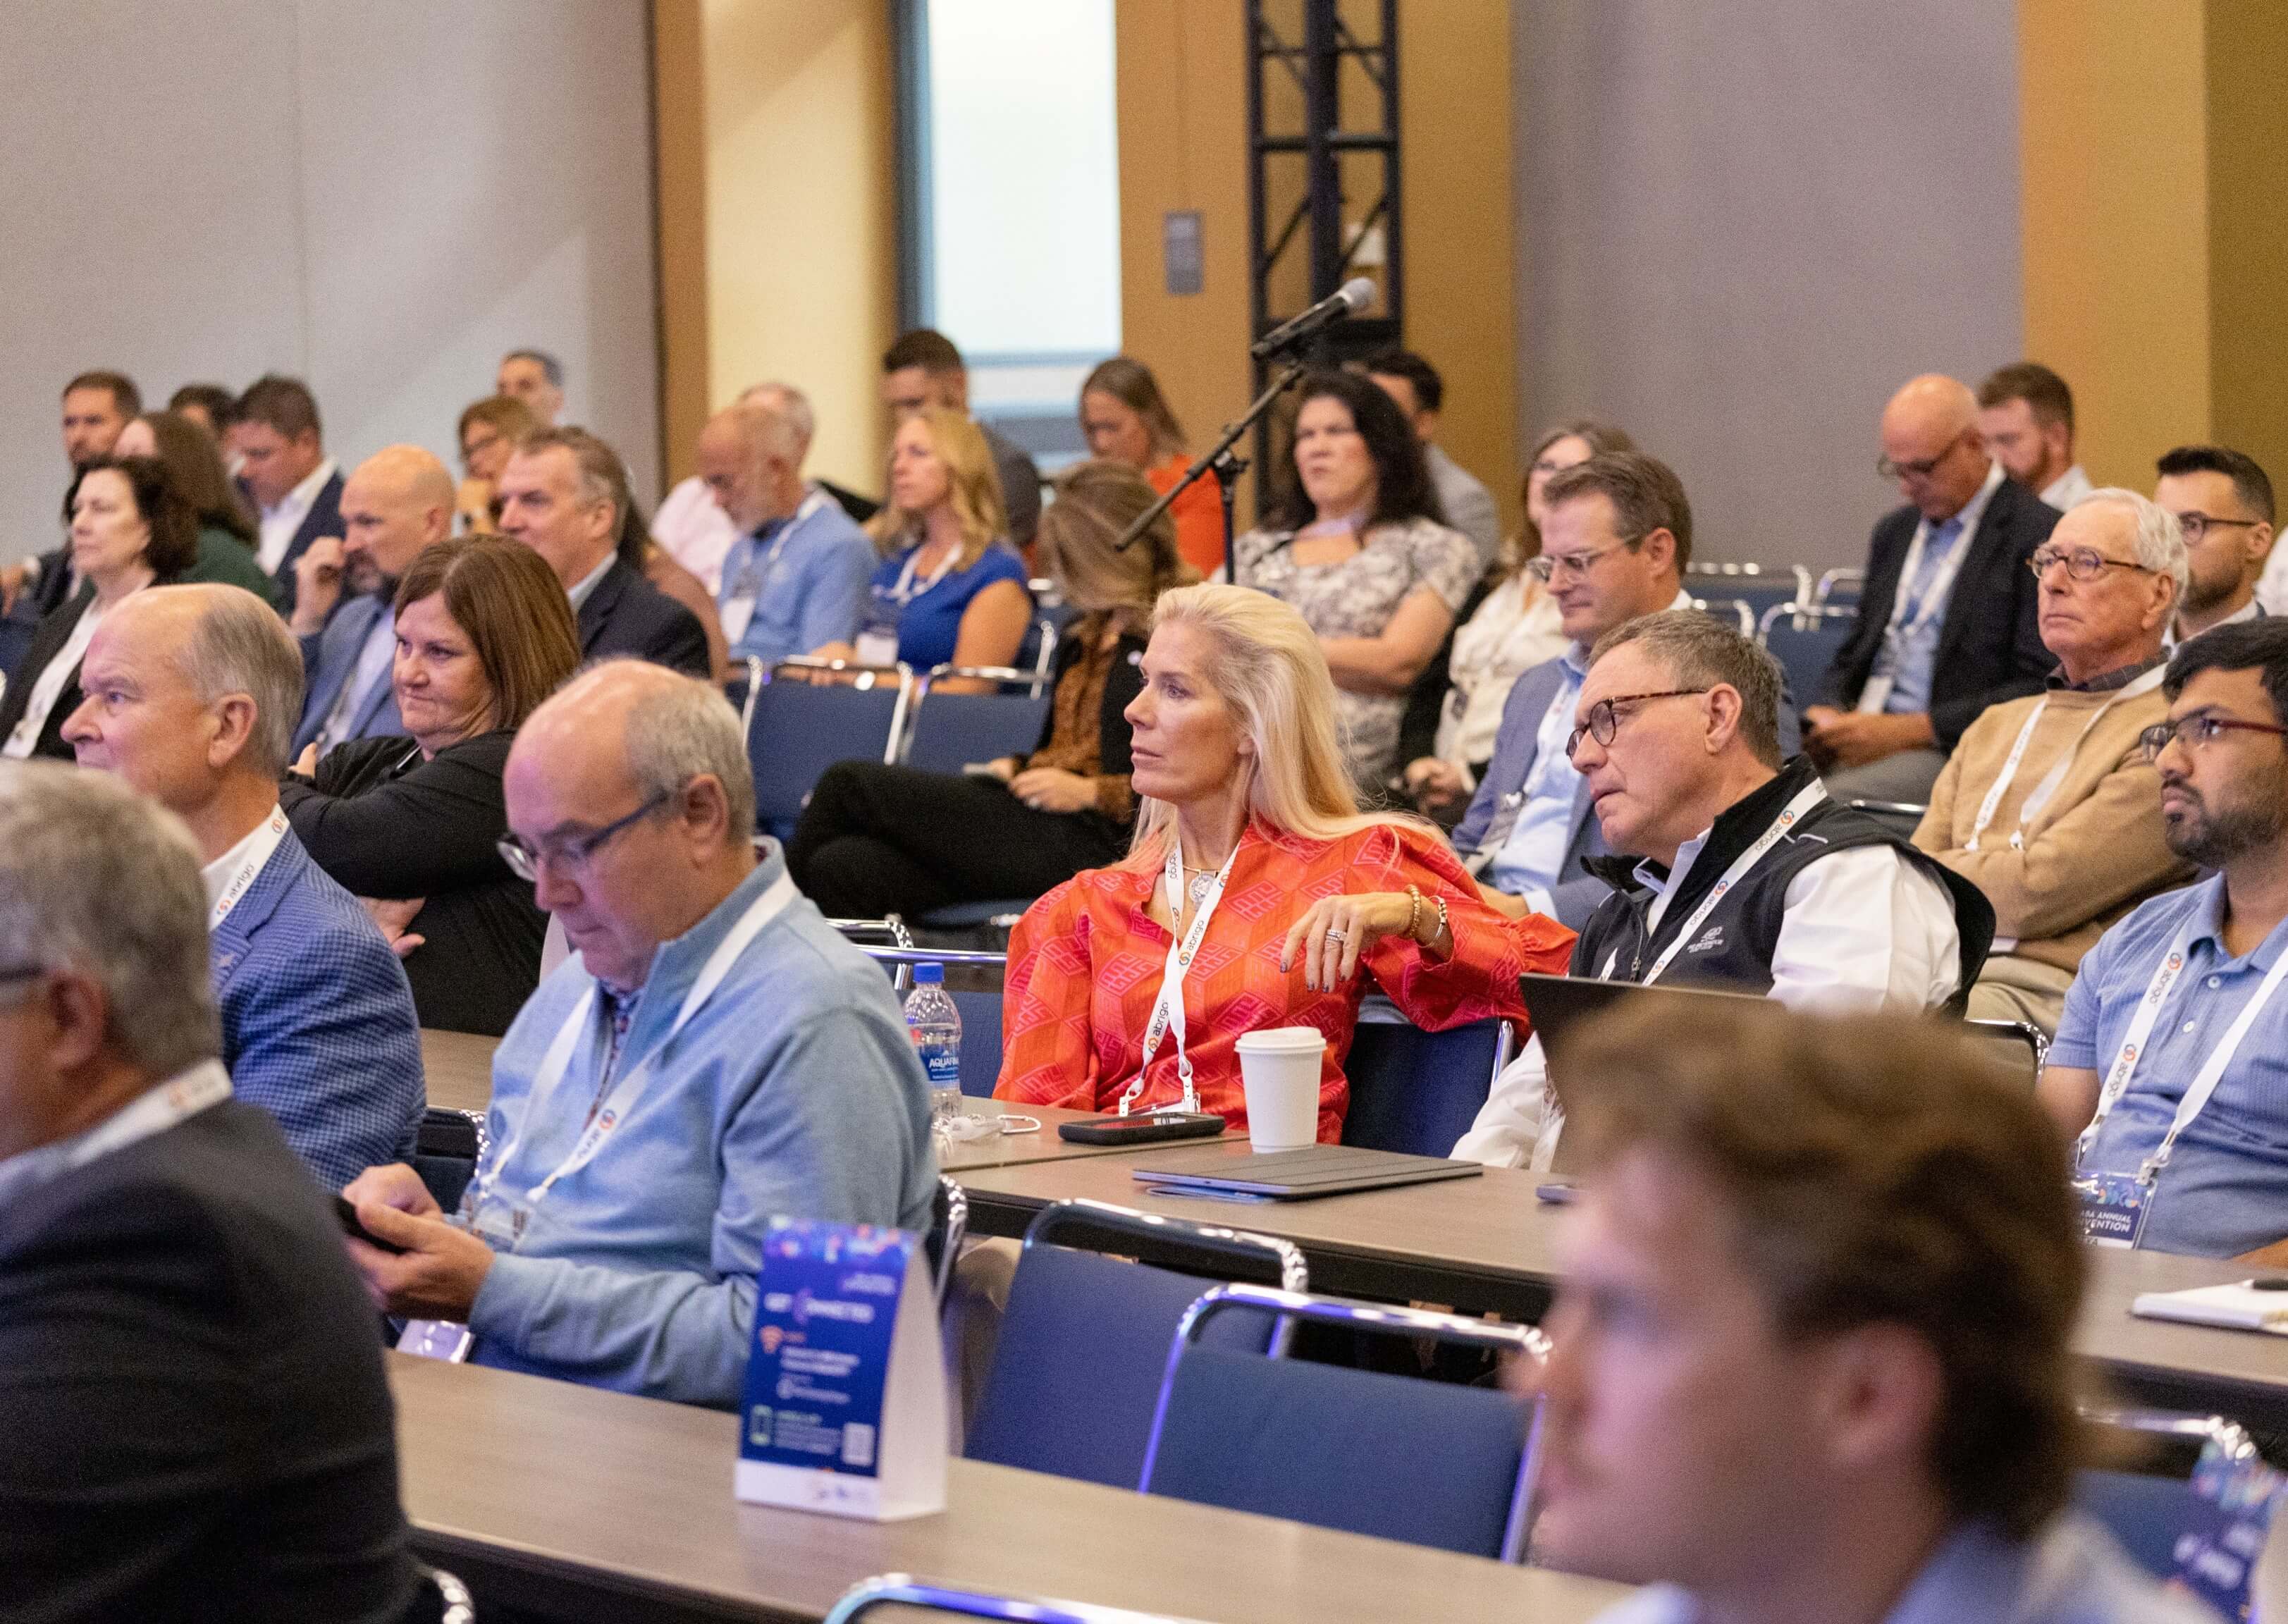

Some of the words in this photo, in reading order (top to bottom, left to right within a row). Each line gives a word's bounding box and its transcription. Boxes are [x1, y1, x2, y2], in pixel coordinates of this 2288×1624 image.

[1186, 920, 1205, 951] abrigo
[1152, 1001, 1169, 1037] abrigo
[2097, 1212, 2132, 1224] ANNUAL
